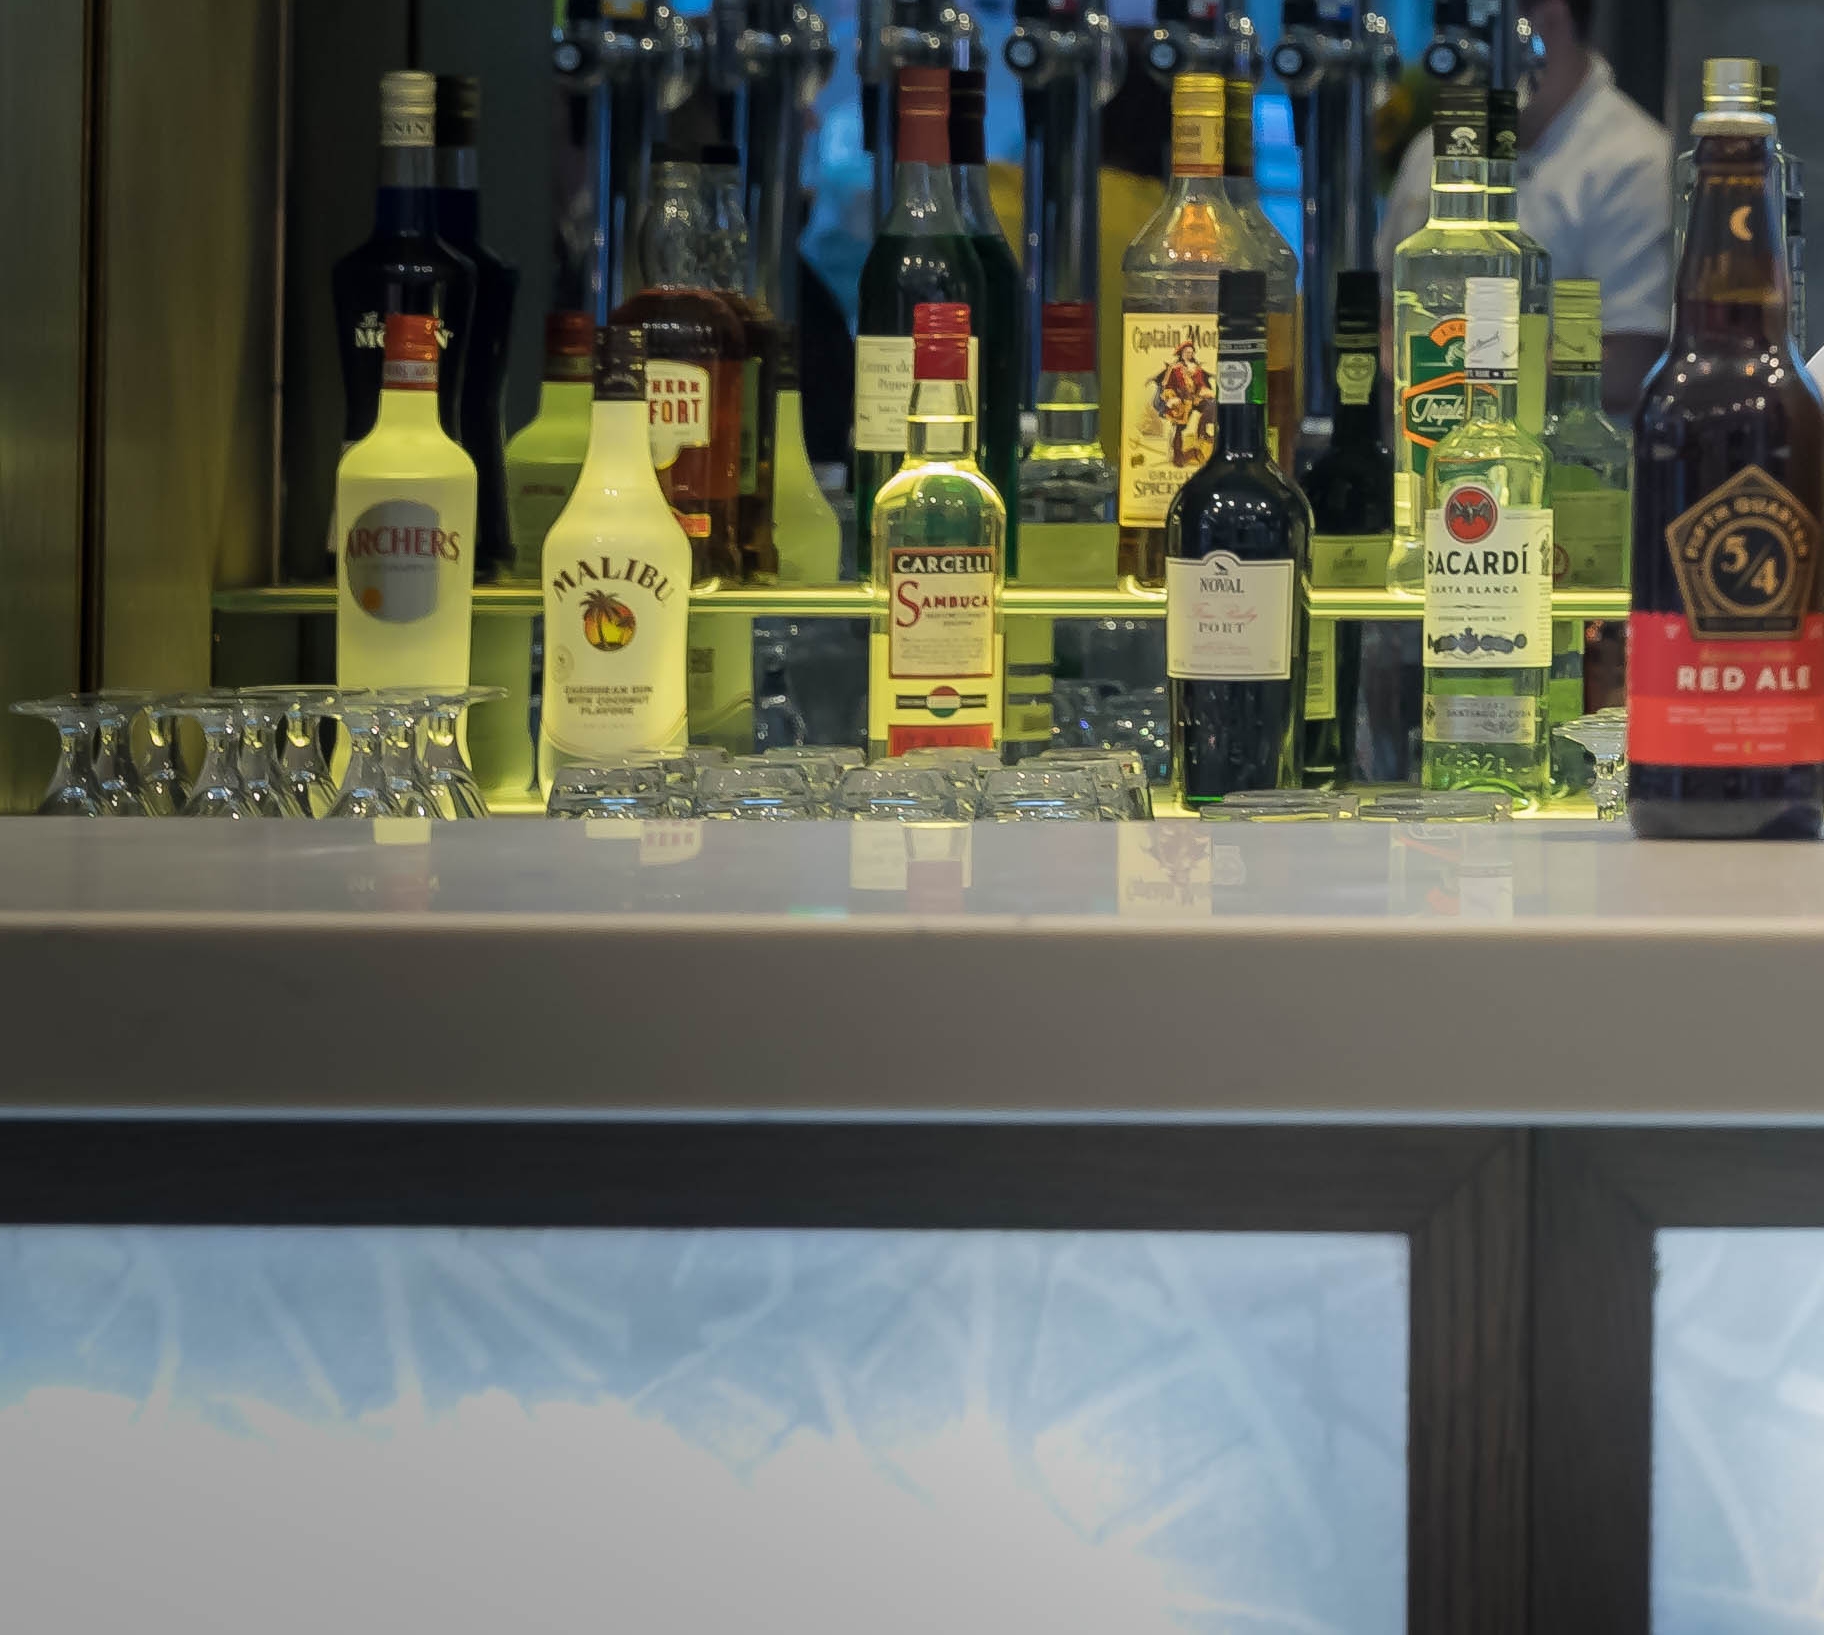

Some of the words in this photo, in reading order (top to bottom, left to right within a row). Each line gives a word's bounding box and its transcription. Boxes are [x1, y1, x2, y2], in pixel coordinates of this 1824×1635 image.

[1133, 325, 1181, 355] Captain
[1182, 325, 1218, 349] Mor
[649, 399, 701, 424] FORT
[348, 526, 460, 564] ARCHERS
[897, 555, 990, 573] CARCELLI
[1720, 534, 1779, 597] 5/4
[552, 556, 675, 607] MALIBU
[1467, 586, 1519, 594] BLANCA
[896, 581, 989, 628] SAMBUCA
[1199, 621, 1244, 633] PORT
[1677, 666, 1746, 692] RED
[1756, 666, 1812, 692] ALE
